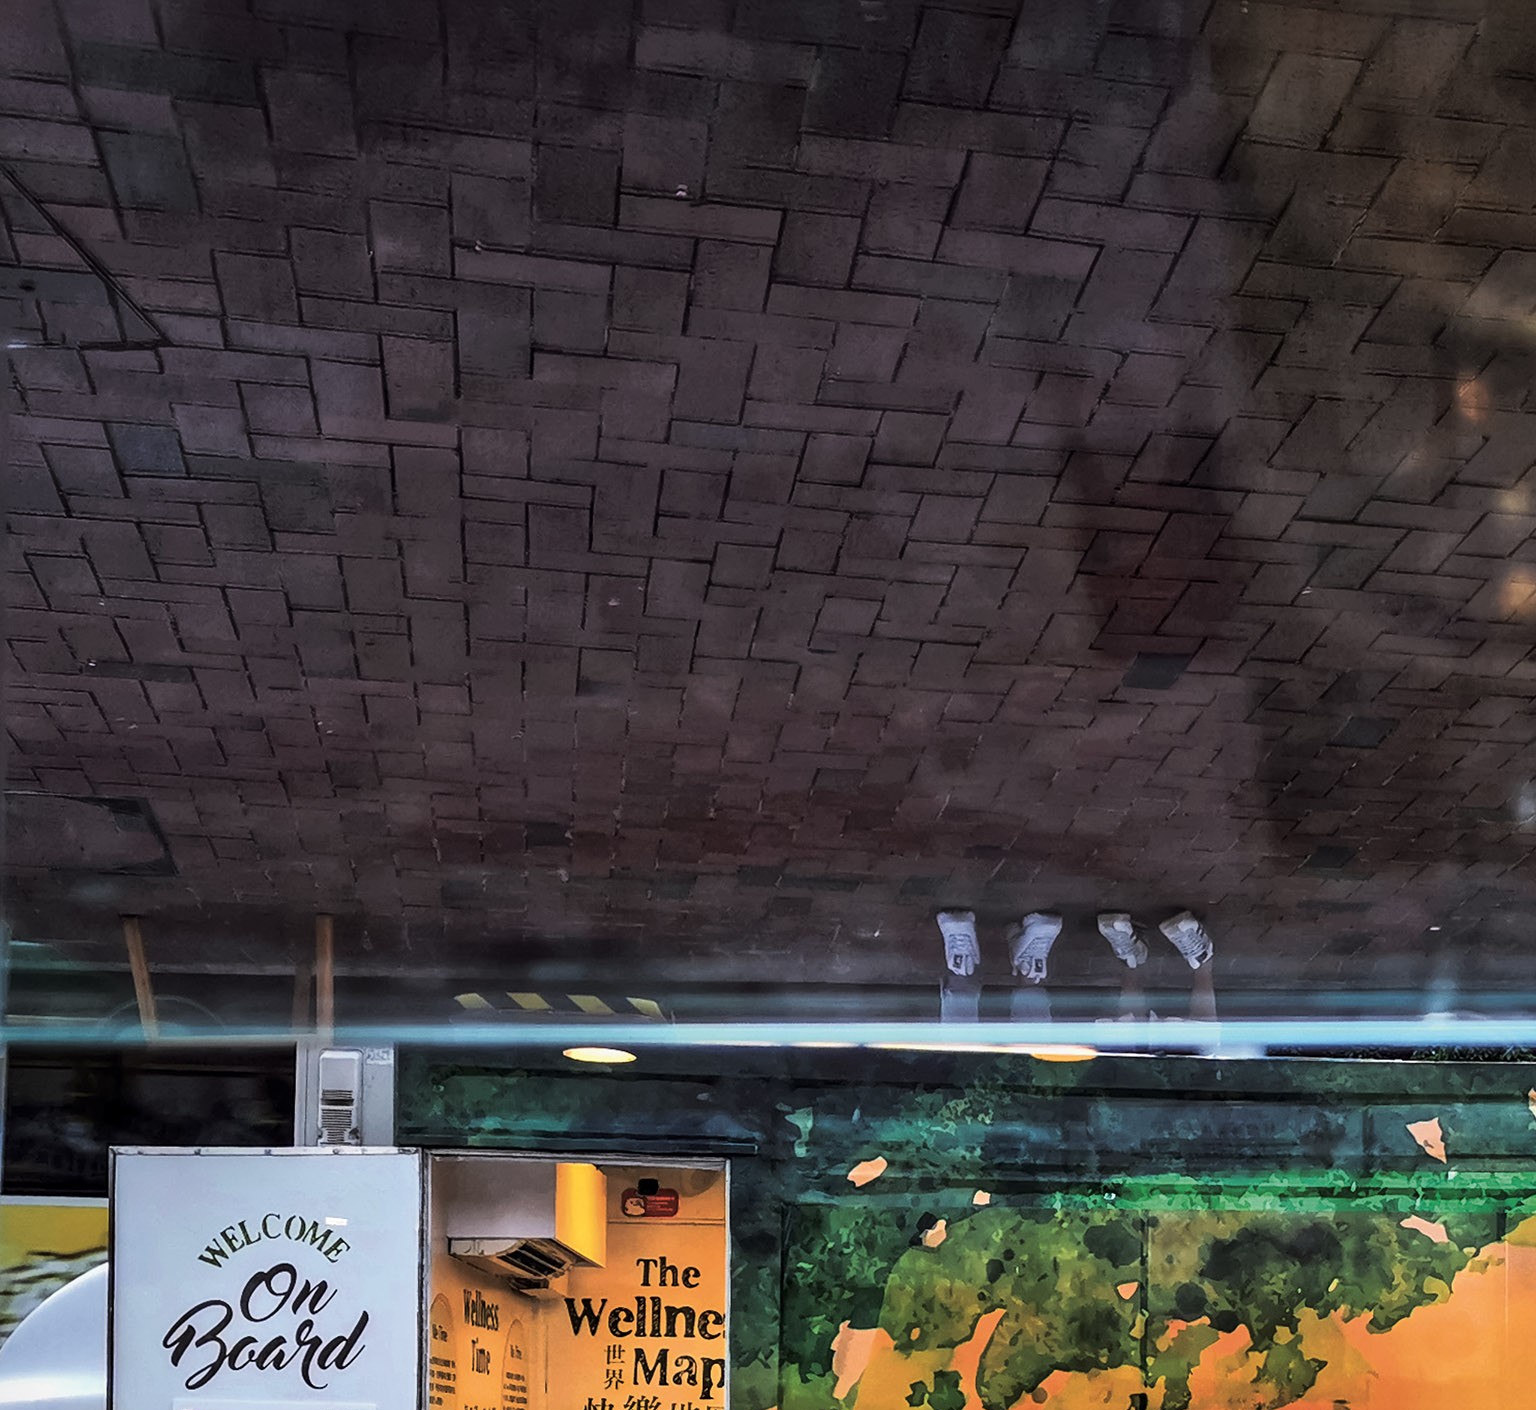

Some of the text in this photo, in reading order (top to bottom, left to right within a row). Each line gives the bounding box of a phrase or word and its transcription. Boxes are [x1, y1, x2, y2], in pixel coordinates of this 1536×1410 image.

[198, 1213, 351, 1268] WELCOME
[240, 1262, 338, 1323] On
[636, 1256, 701, 1289] The
[162, 1299, 369, 1390] Board
[564, 1296, 726, 1340] Wellne
[604, 1344, 626, 1390] 世界
[633, 1347, 725, 1400] Map
